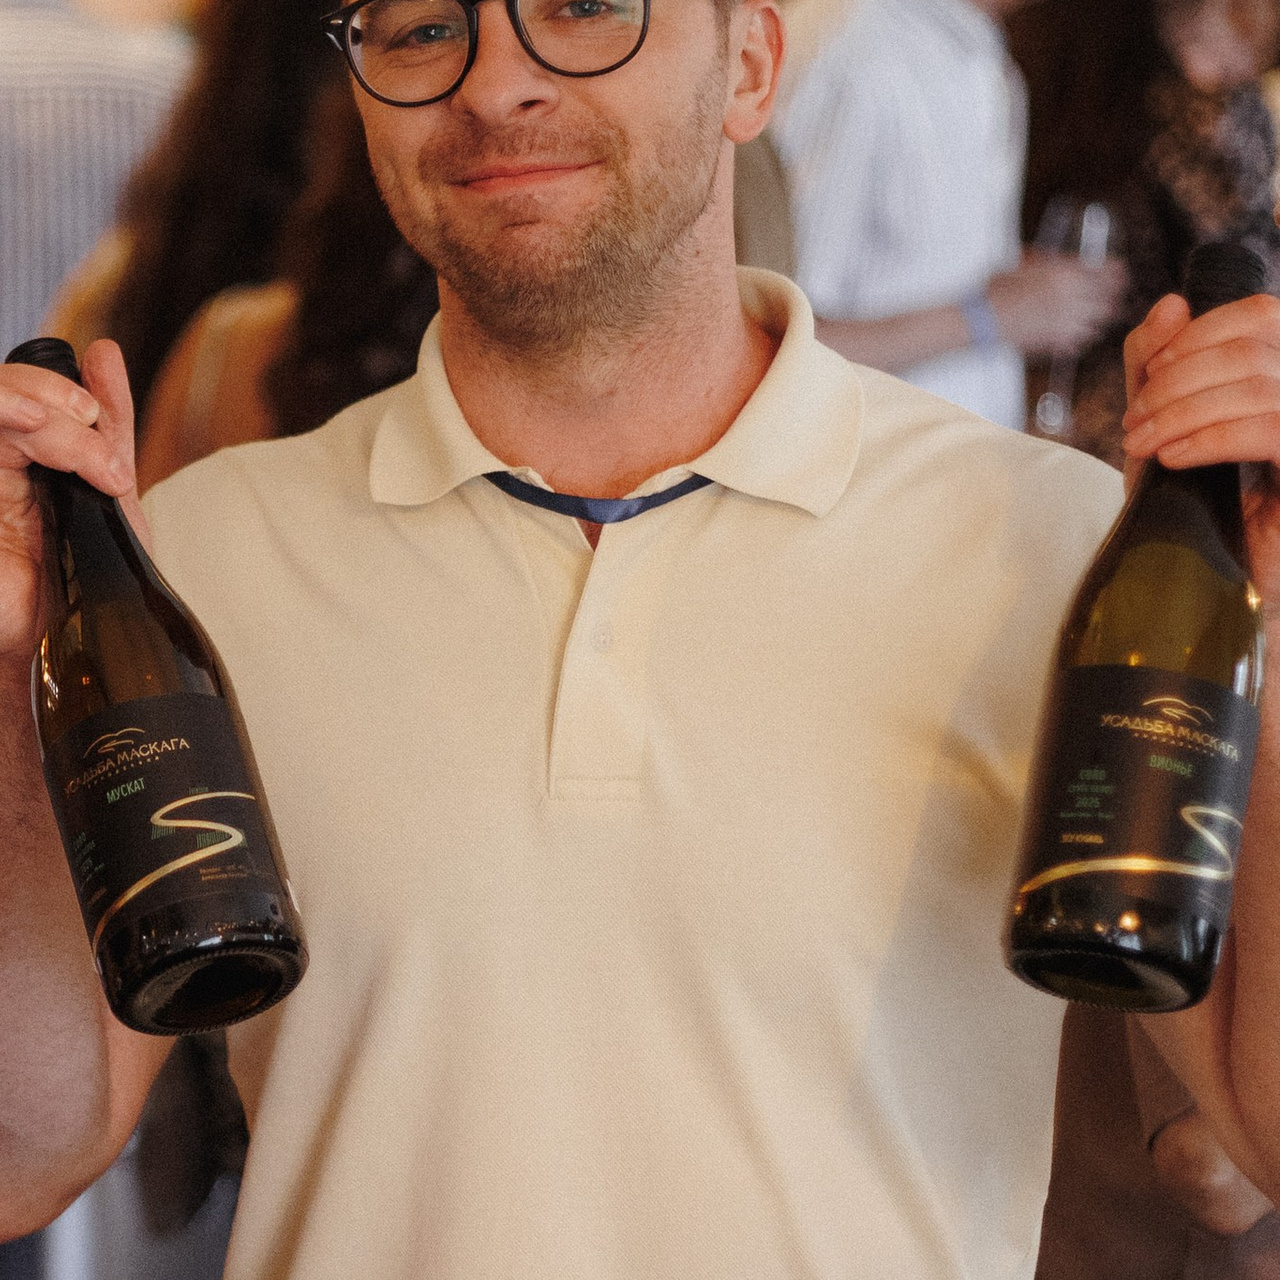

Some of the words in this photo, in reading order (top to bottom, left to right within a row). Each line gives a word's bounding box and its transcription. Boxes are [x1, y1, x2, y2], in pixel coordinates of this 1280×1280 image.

[117, 738, 190, 765] МАСКАГА
[1101, 714, 1175, 736] УСАДЬБА
[1177, 726, 1239, 762] МАСКАГА
[106, 778, 145, 803] МУСКАТ
